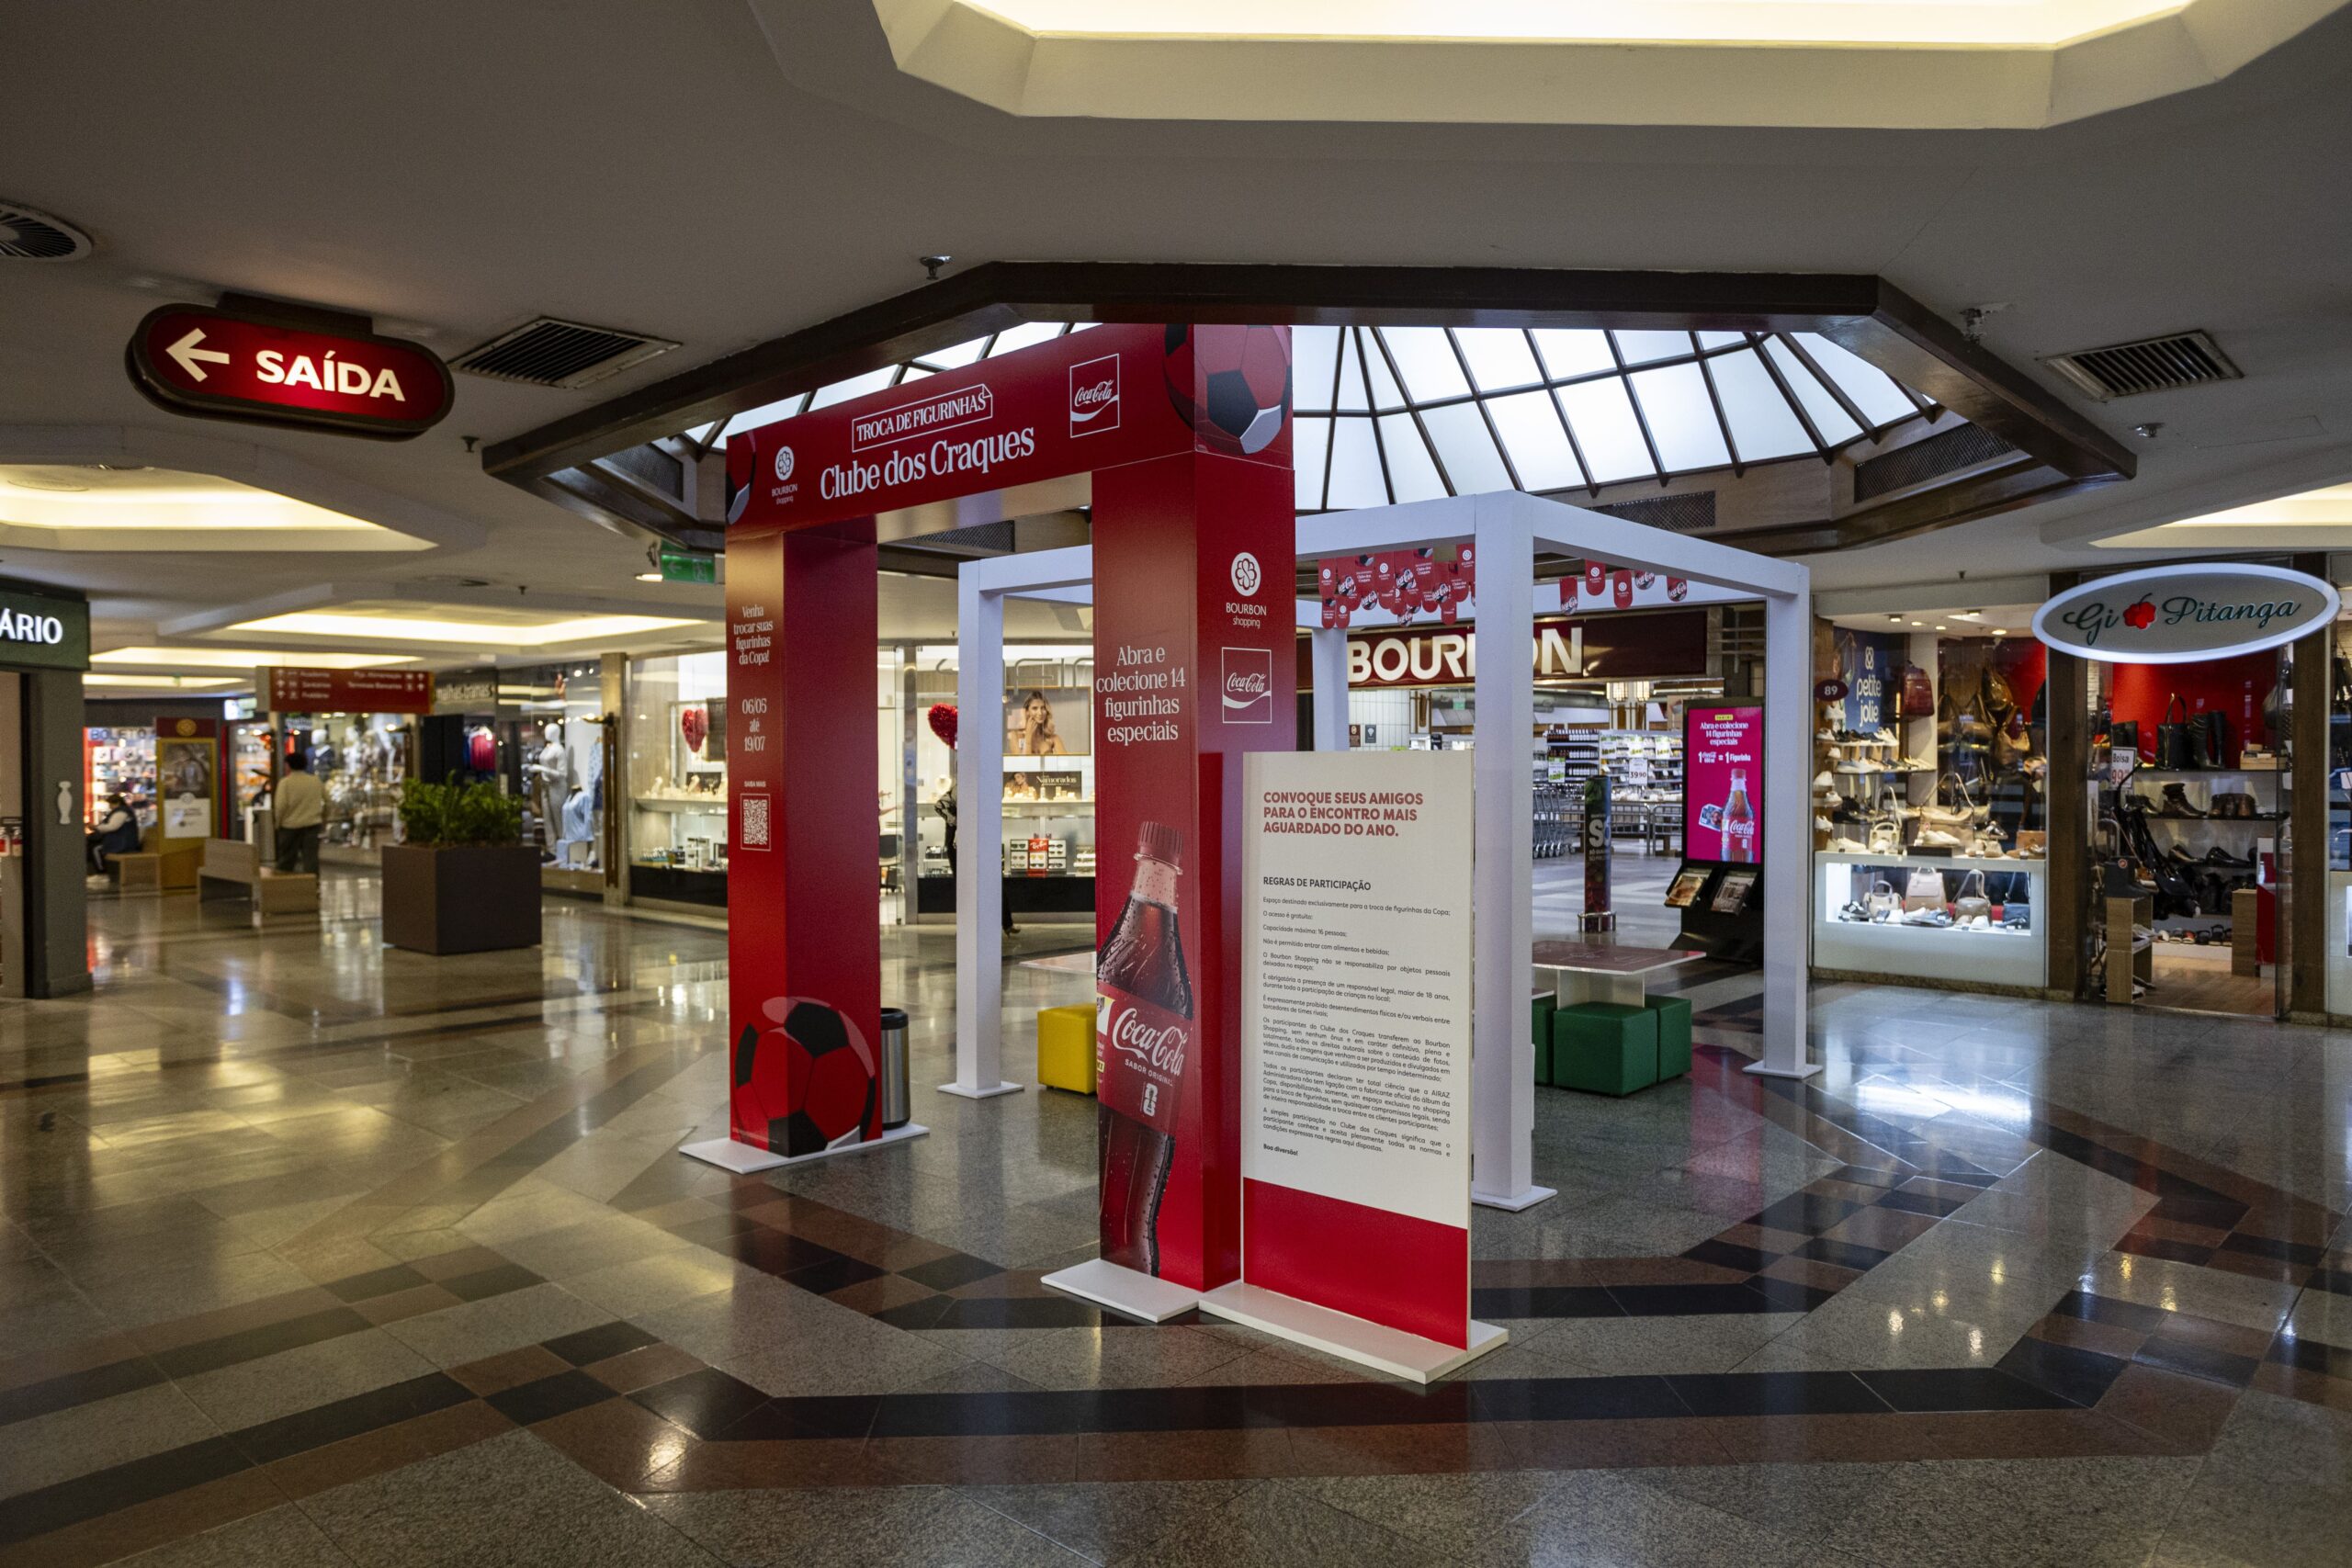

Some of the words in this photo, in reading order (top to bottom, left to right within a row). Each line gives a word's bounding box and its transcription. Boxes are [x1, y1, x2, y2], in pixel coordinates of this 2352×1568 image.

[255, 350, 406, 401] SAÍDA
[1074, 378, 1114, 407] Coca-Cola
[856, 417, 894, 442] TROCA
[897, 412, 912, 432] DE
[913, 392, 987, 428] FIGURINHAS
[820, 460, 880, 501] Clube
[884, 450, 926, 486] dos
[931, 427, 1035, 476] Craques
[772, 483, 798, 497] BOURBON
[742, 604, 764, 618] Venha
[1226, 602, 1267, 616] BOURBON
[2162, 596, 2301, 629] Pitanga
[733, 622, 756, 635] trocar
[756, 620, 774, 632] suas
[1232, 615, 1261, 628] shopping
[2063, 603, 2120, 646] Gi
[736, 635, 772, 651] figurinhas
[739, 652, 749, 666] da
[749, 649, 770, 666] Copa!
[1116, 645, 1152, 666] Abra
[1155, 646, 1166, 662] e
[1348, 626, 1583, 682] BOURN
[1096, 669, 1168, 693] colecione
[1170, 667, 1186, 687] 14
[1227, 671, 1267, 694] Coca-Cola
[1856, 673, 1882, 701] petite
[1824, 685, 1838, 696] 89
[742, 697, 767, 715] 06/05
[1104, 694, 1180, 721] figurinhas
[1859, 699, 1880, 728] jolie
[749, 717, 761, 733] até
[1107, 720, 1179, 746] especiais
[1700, 722, 1714, 730] Abra
[1719, 721, 1749, 729] colecione
[1712, 729, 1743, 739] figurinhas
[744, 736, 765, 751] 19/07
[1710, 738, 1738, 747] especiais
[1263, 792, 1332, 807] CONVOQUE
[1334, 792, 1366, 804] SEUS
[1369, 793, 1424, 806] AMIGOS
[1263, 807, 1295, 818] PARA
[1297, 807, 1307, 818] O
[1310, 807, 1381, 820] ENCONTRO
[1383, 808, 1418, 821] MAIS
[1263, 821, 1341, 835] AGUARDADO
[1344, 823, 1363, 835] DO
[1366, 824, 1399, 837] ANO.
[1263, 876, 1295, 886] REGRAS
[1296, 878, 1307, 887] DE
[1309, 879, 1372, 892] PARTICIPAÇÃO
[1112, 1008, 1189, 1077] Coca-Cola
[1125, 1058, 1147, 1074] SABOR
